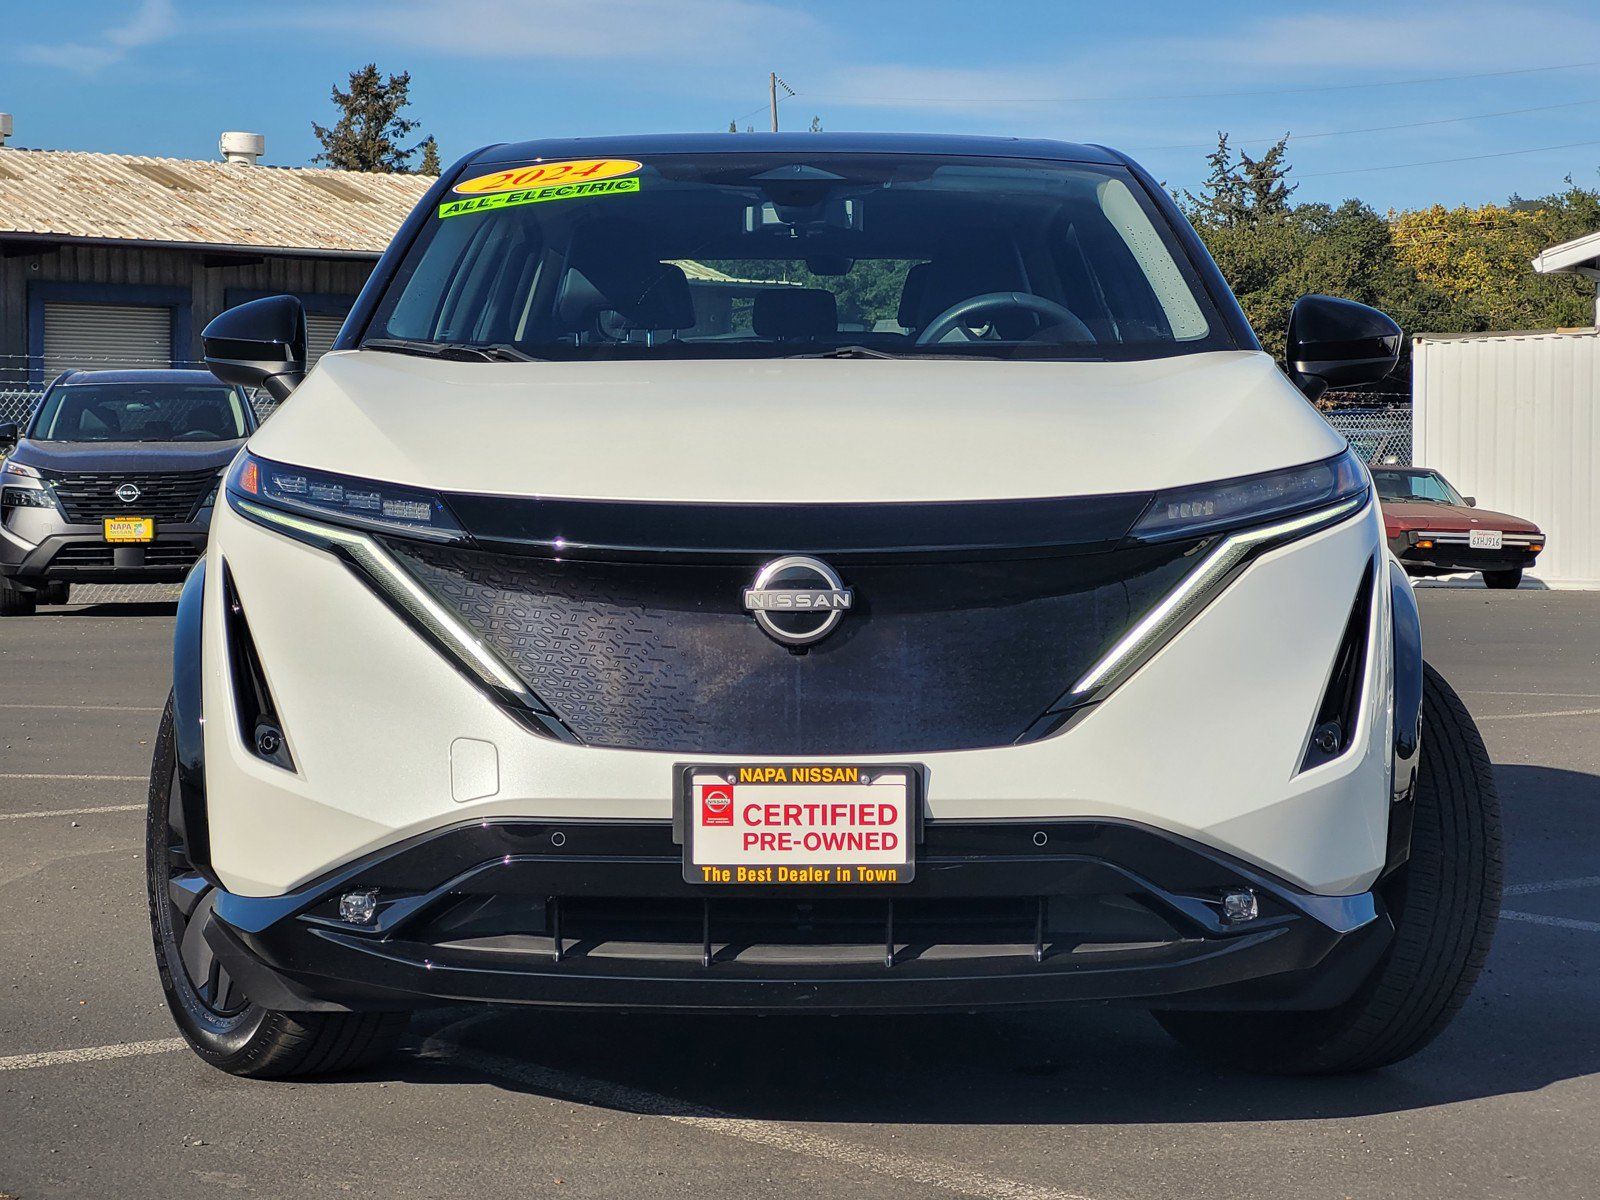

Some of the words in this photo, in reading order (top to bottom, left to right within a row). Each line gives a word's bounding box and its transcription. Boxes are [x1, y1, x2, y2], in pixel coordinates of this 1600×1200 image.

[478, 161, 608, 190] 2024
[443, 179, 637, 215] ALL-ELECTRIC
[1472, 536, 1500, 547] 6XHJ916
[748, 593, 849, 607] NISSAN
[740, 768, 787, 782] NAPA
[792, 768, 858, 782] NISSAN
[743, 804, 898, 826] CERTIFIED
[743, 832, 898, 851] PRE-OWNED
[701, 866, 730, 882] The
[737, 866, 771, 882] Best
[778, 866, 830, 882] Dealer
[837, 867, 851, 882] in
[857, 866, 898, 882] Town
